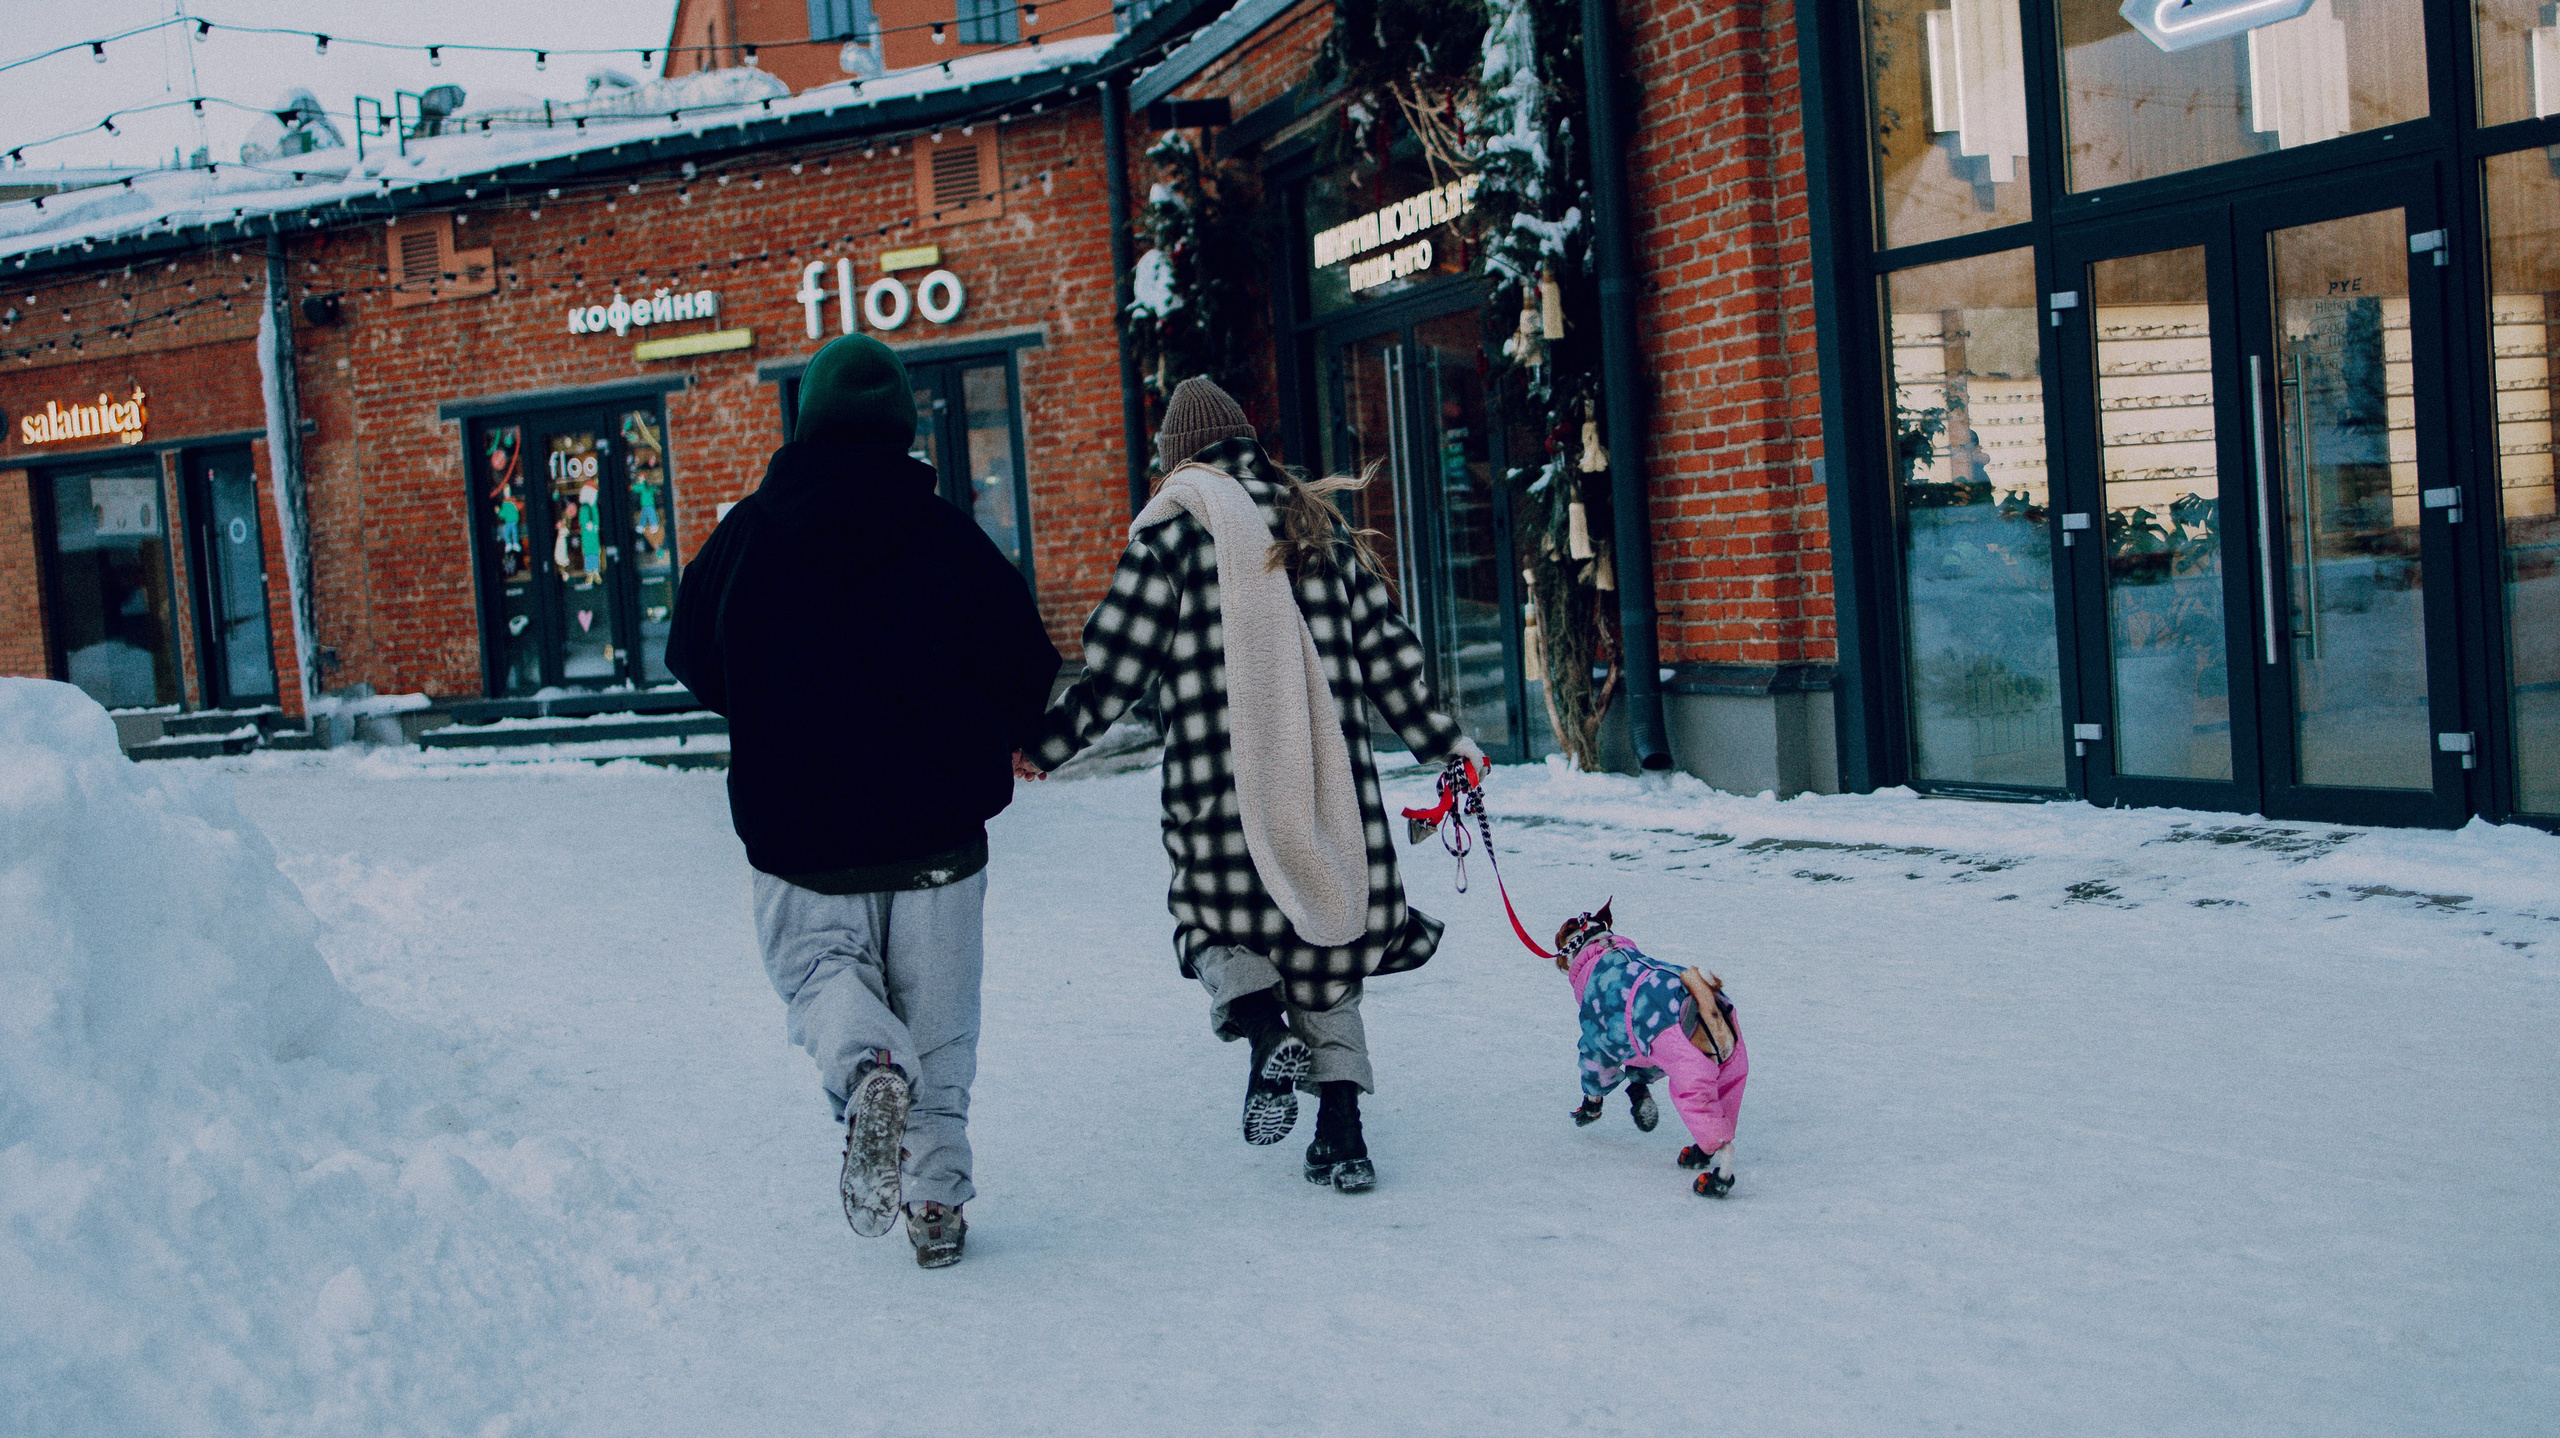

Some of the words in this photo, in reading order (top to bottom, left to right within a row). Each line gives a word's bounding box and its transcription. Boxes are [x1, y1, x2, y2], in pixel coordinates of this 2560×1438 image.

[797, 258, 963, 340] floo
[2328, 277, 2362, 294] PYE
[568, 288, 715, 336] кофейня
[22, 393, 142, 445] salatnica
[549, 451, 599, 480] floo
